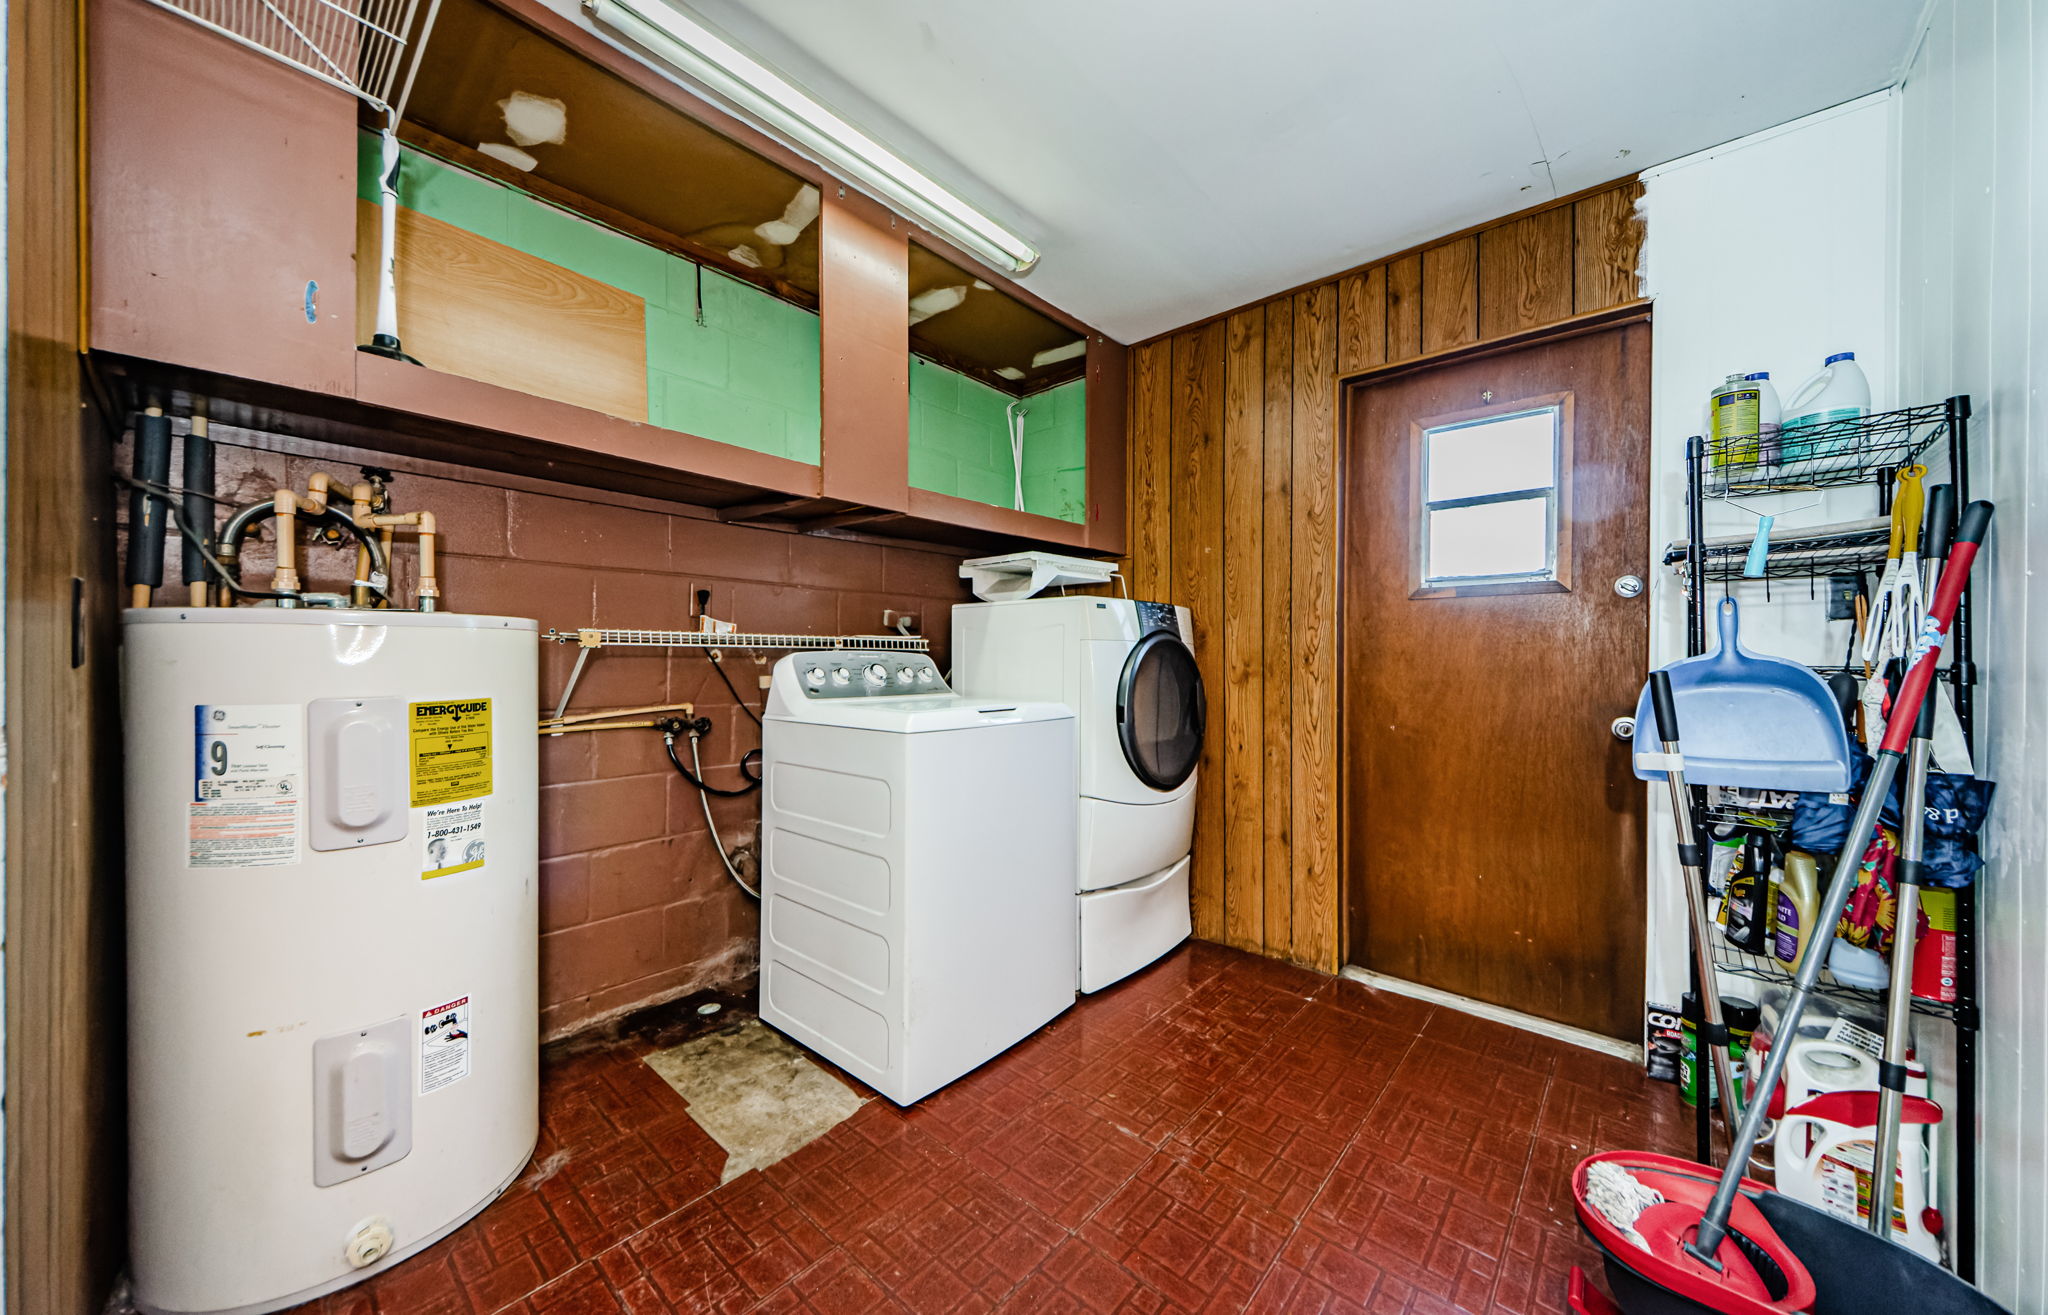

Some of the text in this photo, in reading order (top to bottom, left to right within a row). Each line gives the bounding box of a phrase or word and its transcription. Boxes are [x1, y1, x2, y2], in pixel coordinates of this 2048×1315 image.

[416, 702, 487, 716] ENERGYGUIDE
[211, 740, 228, 776] 9
[427, 808, 445, 817] We're
[446, 807, 461, 815] Here
[469, 802, 483, 810] Help!
[427, 821, 482, 839] 1-800-431-1549
[434, 998, 467, 1015] DANGER
